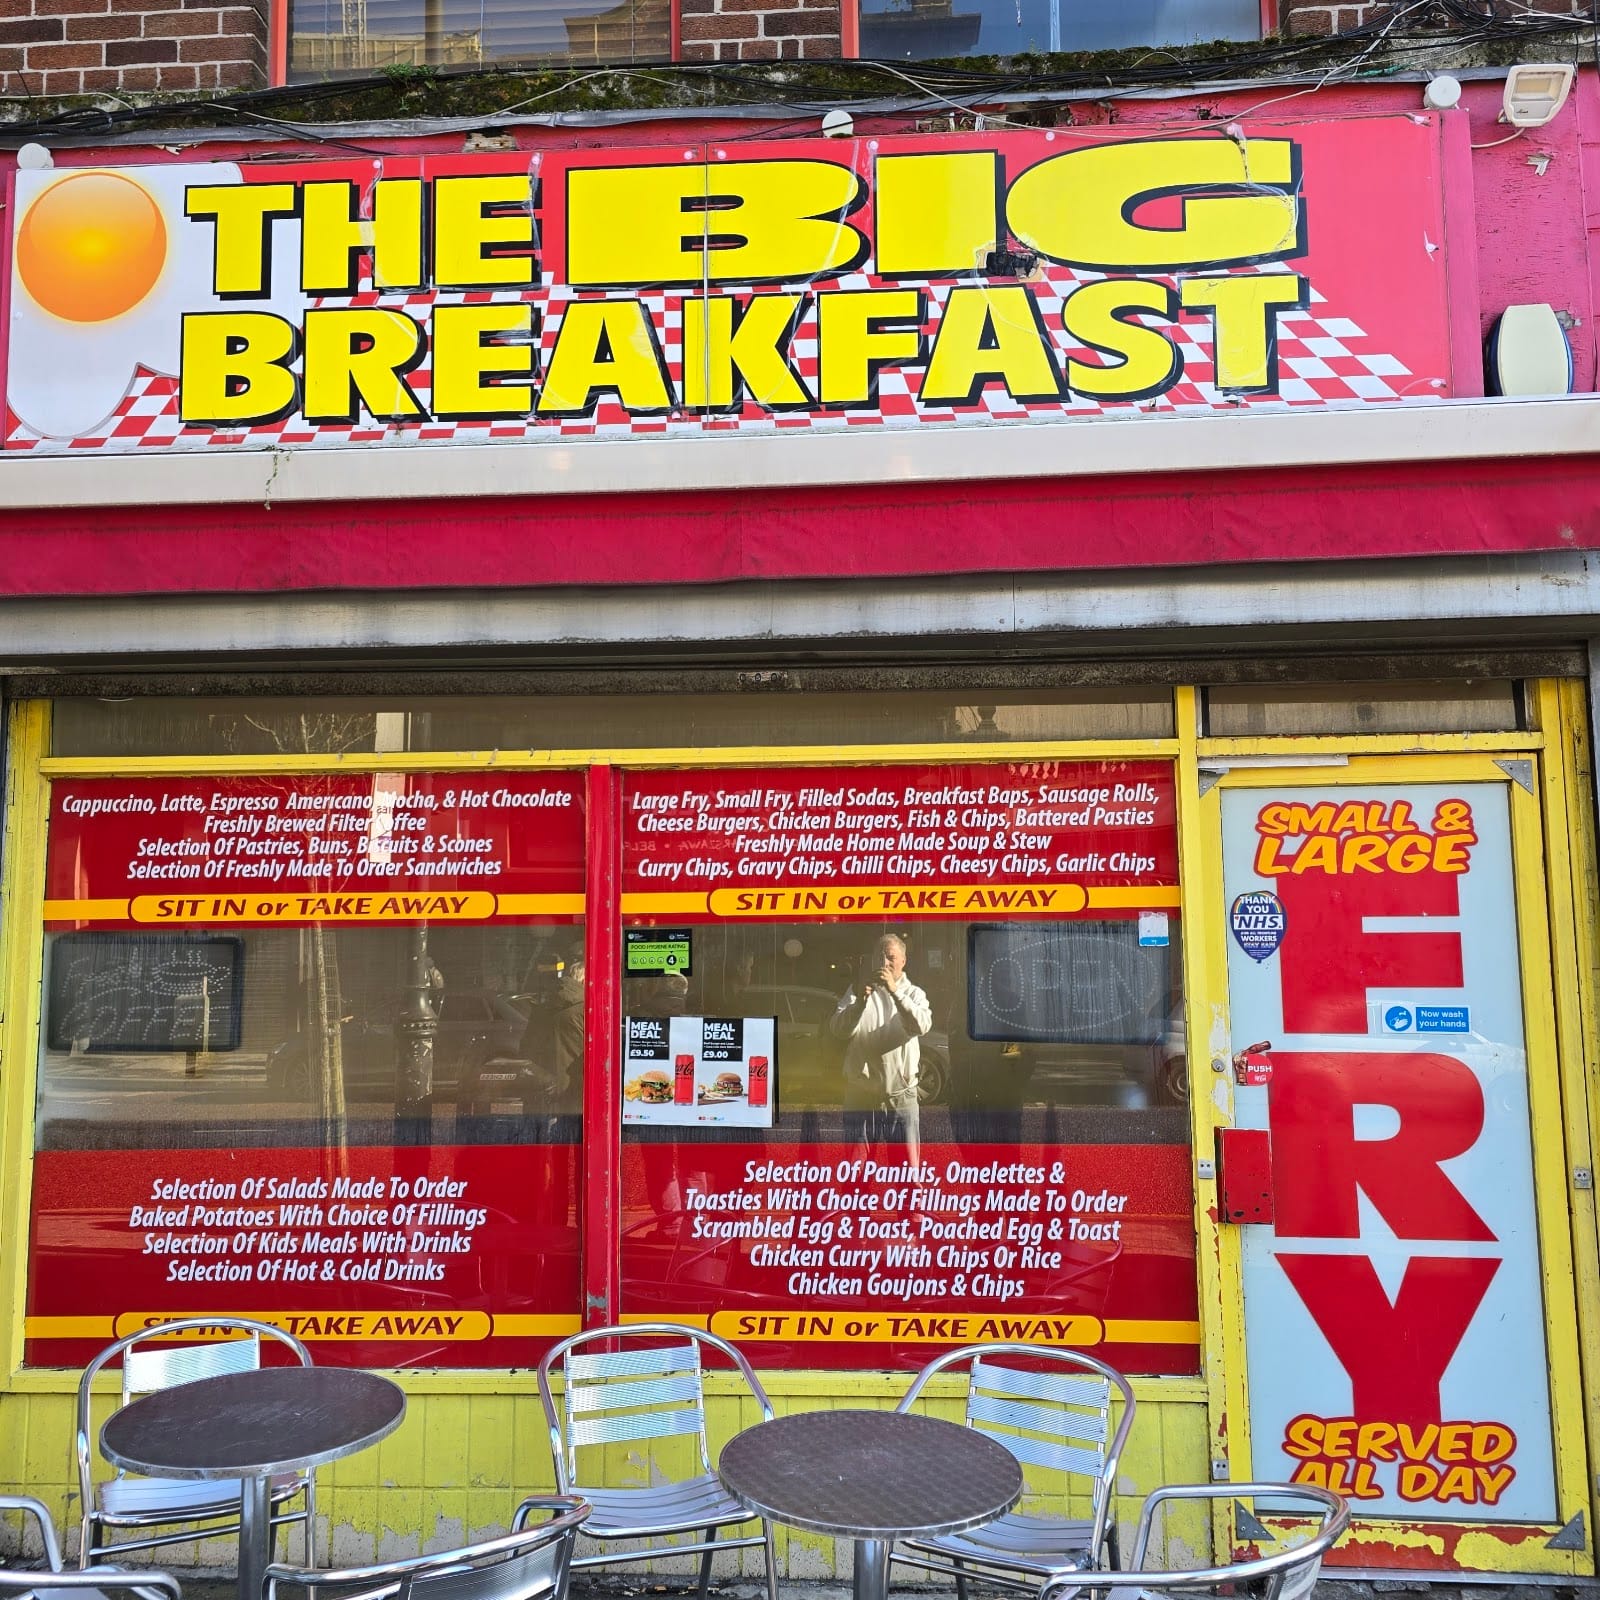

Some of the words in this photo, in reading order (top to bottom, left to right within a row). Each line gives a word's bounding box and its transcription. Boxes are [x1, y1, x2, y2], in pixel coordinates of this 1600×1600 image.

[184, 173, 541, 301] THE
[564, 137, 1308, 291] BIG
[180, 274, 1310, 428] BREAKFAST
[63, 794, 156, 817] Cappuccino,
[161, 794, 206, 813] Latte,
[210, 793, 278, 814] Espresso
[459, 790, 489, 807] Hot
[492, 789, 571, 807] Chocolate
[633, 792, 678, 813] Large
[682, 791, 711, 813] Fry,
[715, 790, 762, 808] Small
[765, 790, 794, 811] Fry,
[798, 788, 844, 806] Filled
[847, 788, 899, 808] Sodas,
[904, 786, 985, 805] Breakfast
[988, 786, 1034, 808] Baps,
[1038, 785, 1110, 809] Sausage
[1113, 783, 1160, 804] Rolls,
[204, 815, 262, 837] Freshly
[265, 814, 327, 832] Brewed
[329, 813, 373, 832] Filter
[375, 813, 427, 831] offee
[638, 814, 693, 831] Cheese
[696, 813, 764, 835] Burgers,
[769, 811, 831, 830] Chicken
[835, 811, 903, 833] Burgers,
[908, 810, 940, 827] Fish
[962, 809, 1011, 831] Chips,
[1015, 809, 1090, 827] Battered
[1094, 807, 1154, 825] Pasties
[1255, 800, 1421, 834] SMALL
[1433, 798, 1476, 834] &
[137, 838, 210, 856] Selection
[214, 837, 235, 855] Of
[236, 837, 304, 857] Pastries,
[308, 837, 352, 856] Buns,
[438, 835, 492, 853] Scones
[735, 834, 795, 857] Freshly
[797, 834, 843, 851] Made
[847, 834, 894, 851] Home
[898, 832, 945, 851] Made
[948, 832, 989, 854] Soup
[1010, 831, 1053, 850] Stew
[1254, 832, 1478, 878] LARGE
[127, 861, 200, 878] Selection
[226, 859, 285, 881] Freshly
[287, 859, 332, 877] Made
[337, 859, 353, 876] To
[356, 858, 402, 877] Order
[405, 857, 501, 875] Sandwiches
[638, 859, 682, 881] Curry
[686, 858, 733, 880] Chips,
[738, 858, 786, 880] Gravy
[789, 856, 837, 878] Chips,
[842, 856, 884, 874] Chilli
[887, 855, 935, 877] Chips,
[941, 855, 998, 877] Cheesy
[1002, 854, 1051, 876] Chips,
[1056, 854, 1106, 872] Garlic
[1110, 853, 1155, 875] Chips
[157, 900, 205, 916] SIT
[212, 899, 246, 916] IN
[257, 903, 288, 915] or
[297, 898, 372, 914] TAKE
[379, 897, 468, 914] AWAY
[737, 894, 785, 910] SIT
[793, 893, 827, 909] IN
[839, 896, 871, 909] or
[879, 891, 956, 908] TAKE
[965, 890, 1056, 907] AWAY
[1240, 896, 1276, 904] THANK
[1246, 905, 1269, 914] YOU
[668, 956, 675, 964] 4
[1419, 1020, 1439, 1028] your
[1440, 1019, 1467, 1028] hands
[1421, 1010, 1440, 1018] Now
[1441, 1010, 1464, 1018] wash
[630, 1030, 661, 1039] DEAL
[631, 1021, 662, 1031] MEAL
[703, 1022, 736, 1032] MEAL
[703, 1031, 734, 1041] DEAL
[630, 1049, 655, 1057] £9.50
[703, 1050, 729, 1059] £9.00
[1248, 1065, 1272, 1073] PUSH
[744, 1160, 831, 1182] Selection
[863, 1161, 942, 1186] Paninis,
[947, 1161, 1045, 1183] Omelettes
[151, 1178, 236, 1199] Selection
[266, 1177, 328, 1198] Salads
[331, 1177, 385, 1198] Made
[390, 1177, 409, 1198] To
[414, 1176, 467, 1198] Order
[686, 1188, 762, 1210] Toasties
[768, 1188, 811, 1210] With
[817, 1188, 879, 1211] Choice
[883, 1189, 908, 1210] Of
[910, 1189, 982, 1217] Fillings
[985, 1190, 1040, 1211] Made
[1046, 1190, 1066, 1211] To
[1071, 1190, 1127, 1212] Order
[130, 1205, 189, 1226] Baked
[192, 1206, 274, 1226] Potatoes
[280, 1204, 323, 1226] With
[328, 1204, 388, 1225] Choice
[418, 1204, 486, 1230] Fillings
[692, 1216, 795, 1239] Scrambled
[798, 1217, 834, 1244] Egg
[859, 1217, 916, 1242] Toast,
[919, 1216, 1004, 1240] Poached
[1007, 1218, 1043, 1245] Egg
[1069, 1219, 1121, 1240] Toast
[143, 1232, 228, 1254] Selection
[258, 1232, 298, 1253] Kids
[301, 1232, 357, 1253] Meals
[363, 1231, 406, 1253] With
[410, 1231, 471, 1252] Drinks
[167, 1260, 252, 1281] Selection
[283, 1260, 318, 1280] Hot
[340, 1259, 382, 1280] Cold
[384, 1259, 445, 1280] Drinks
[751, 1244, 823, 1266] Chicken
[829, 1245, 882, 1272] Curry
[887, 1244, 931, 1267] With
[937, 1245, 989, 1273] Chips
[994, 1246, 1017, 1268] Or
[1021, 1246, 1061, 1268] Rice
[789, 1272, 862, 1294] Chicken
[868, 1273, 947, 1301] Goujons
[972, 1274, 1024, 1302] Chips
[286, 1317, 364, 1335] TAKE
[371, 1317, 463, 1335] AWAY
[739, 1317, 789, 1335] SIT
[797, 1317, 833, 1335] IN
[845, 1322, 879, 1336] or
[887, 1319, 968, 1337] TAKE
[976, 1320, 1072, 1339] AWAY
[1282, 1413, 1517, 1464] SERVED
[1289, 1458, 1384, 1500] ALL
[1398, 1462, 1517, 1506] DAY
